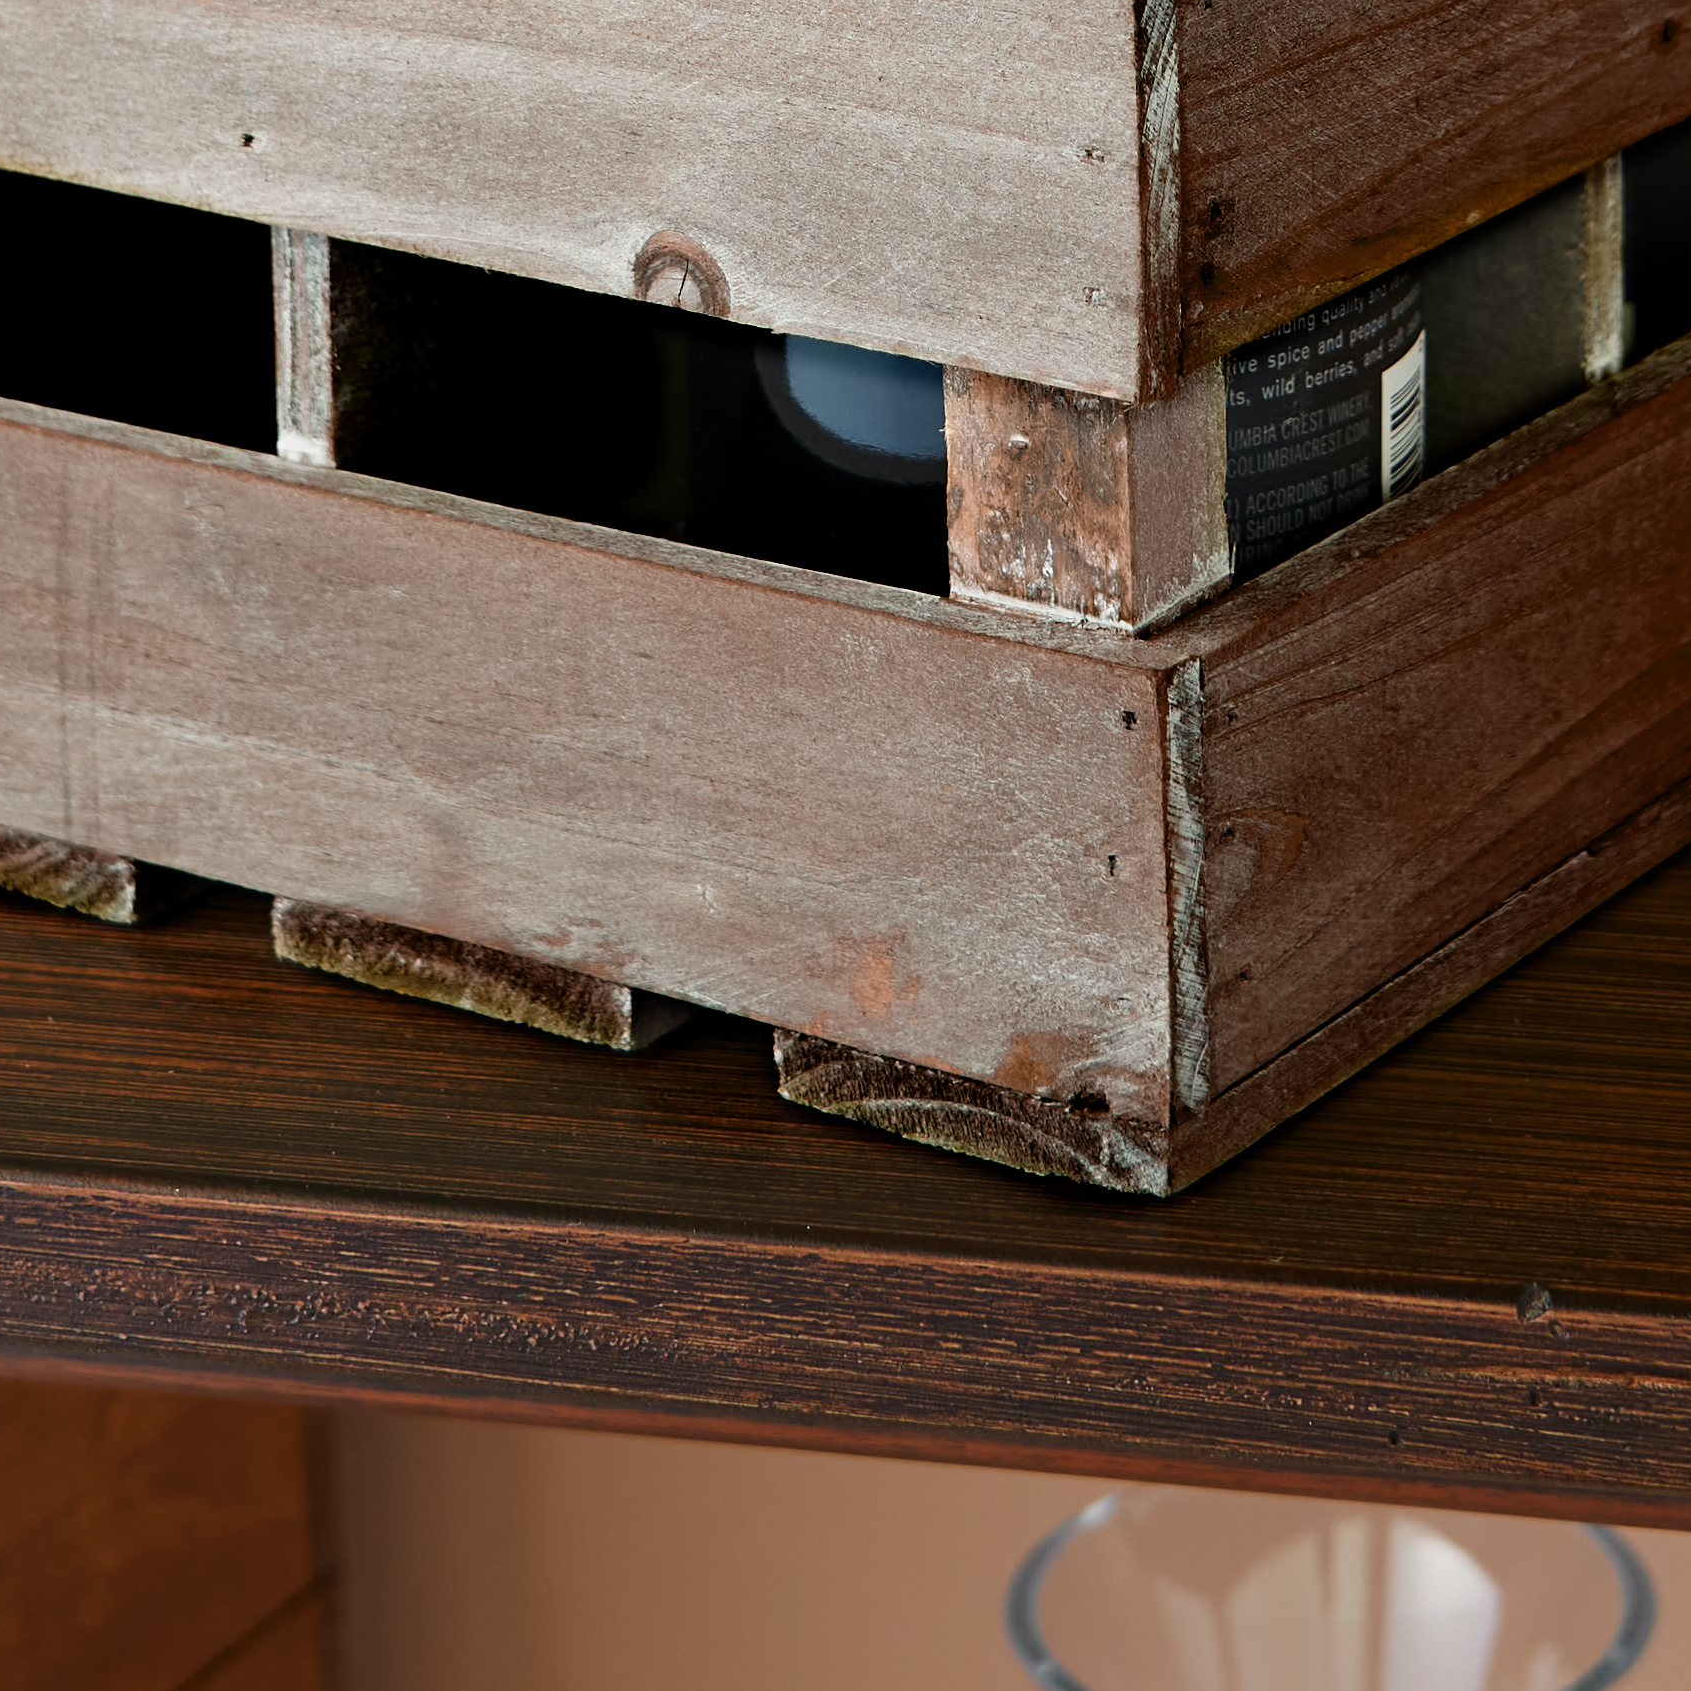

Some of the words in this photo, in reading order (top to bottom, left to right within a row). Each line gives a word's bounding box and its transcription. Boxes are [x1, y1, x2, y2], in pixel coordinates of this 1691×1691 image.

[1321, 296, 1365, 325] quality
[1267, 345, 1311, 370] spice
[1317, 329, 1345, 356] and
[1350, 312, 1389, 347] pepper
[1262, 375, 1296, 400] wild
[1364, 338, 1384, 367] and
[1228, 422, 1278, 451] UMBIA
[1281, 408, 1325, 441] CREST
[1246, 474, 1329, 516] ACCORDING
[1332, 467, 1349, 492] TO
[1246, 508, 1304, 541] SHOULD
